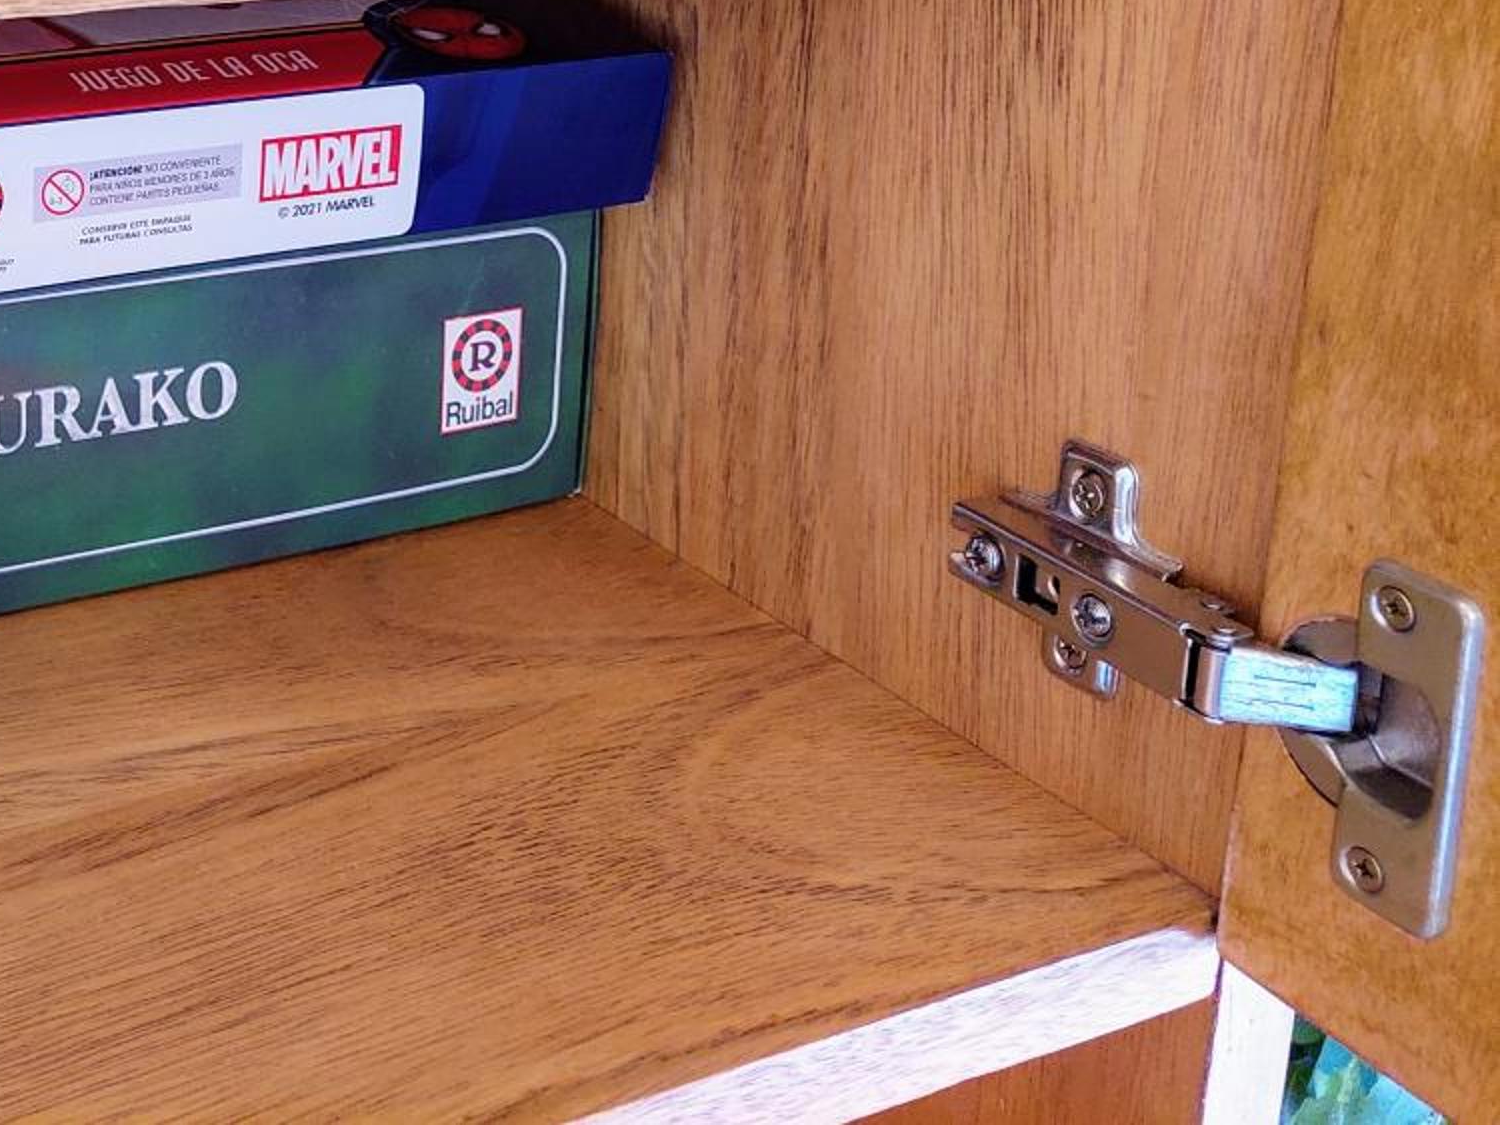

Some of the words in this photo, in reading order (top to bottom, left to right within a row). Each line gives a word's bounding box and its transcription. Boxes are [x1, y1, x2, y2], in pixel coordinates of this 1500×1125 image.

[69, 64, 163, 93] JUEGO
[162, 60, 210, 84] DE
[206, 55, 254, 78] LA
[251, 49, 319, 73] OCA
[262, 130, 397, 198] MARVEL
[292, 202, 322, 217] 2021
[325, 195, 375, 213] MARVEL
[469, 341, 496, 372] R
[446, 391, 513, 427] Ruibal
